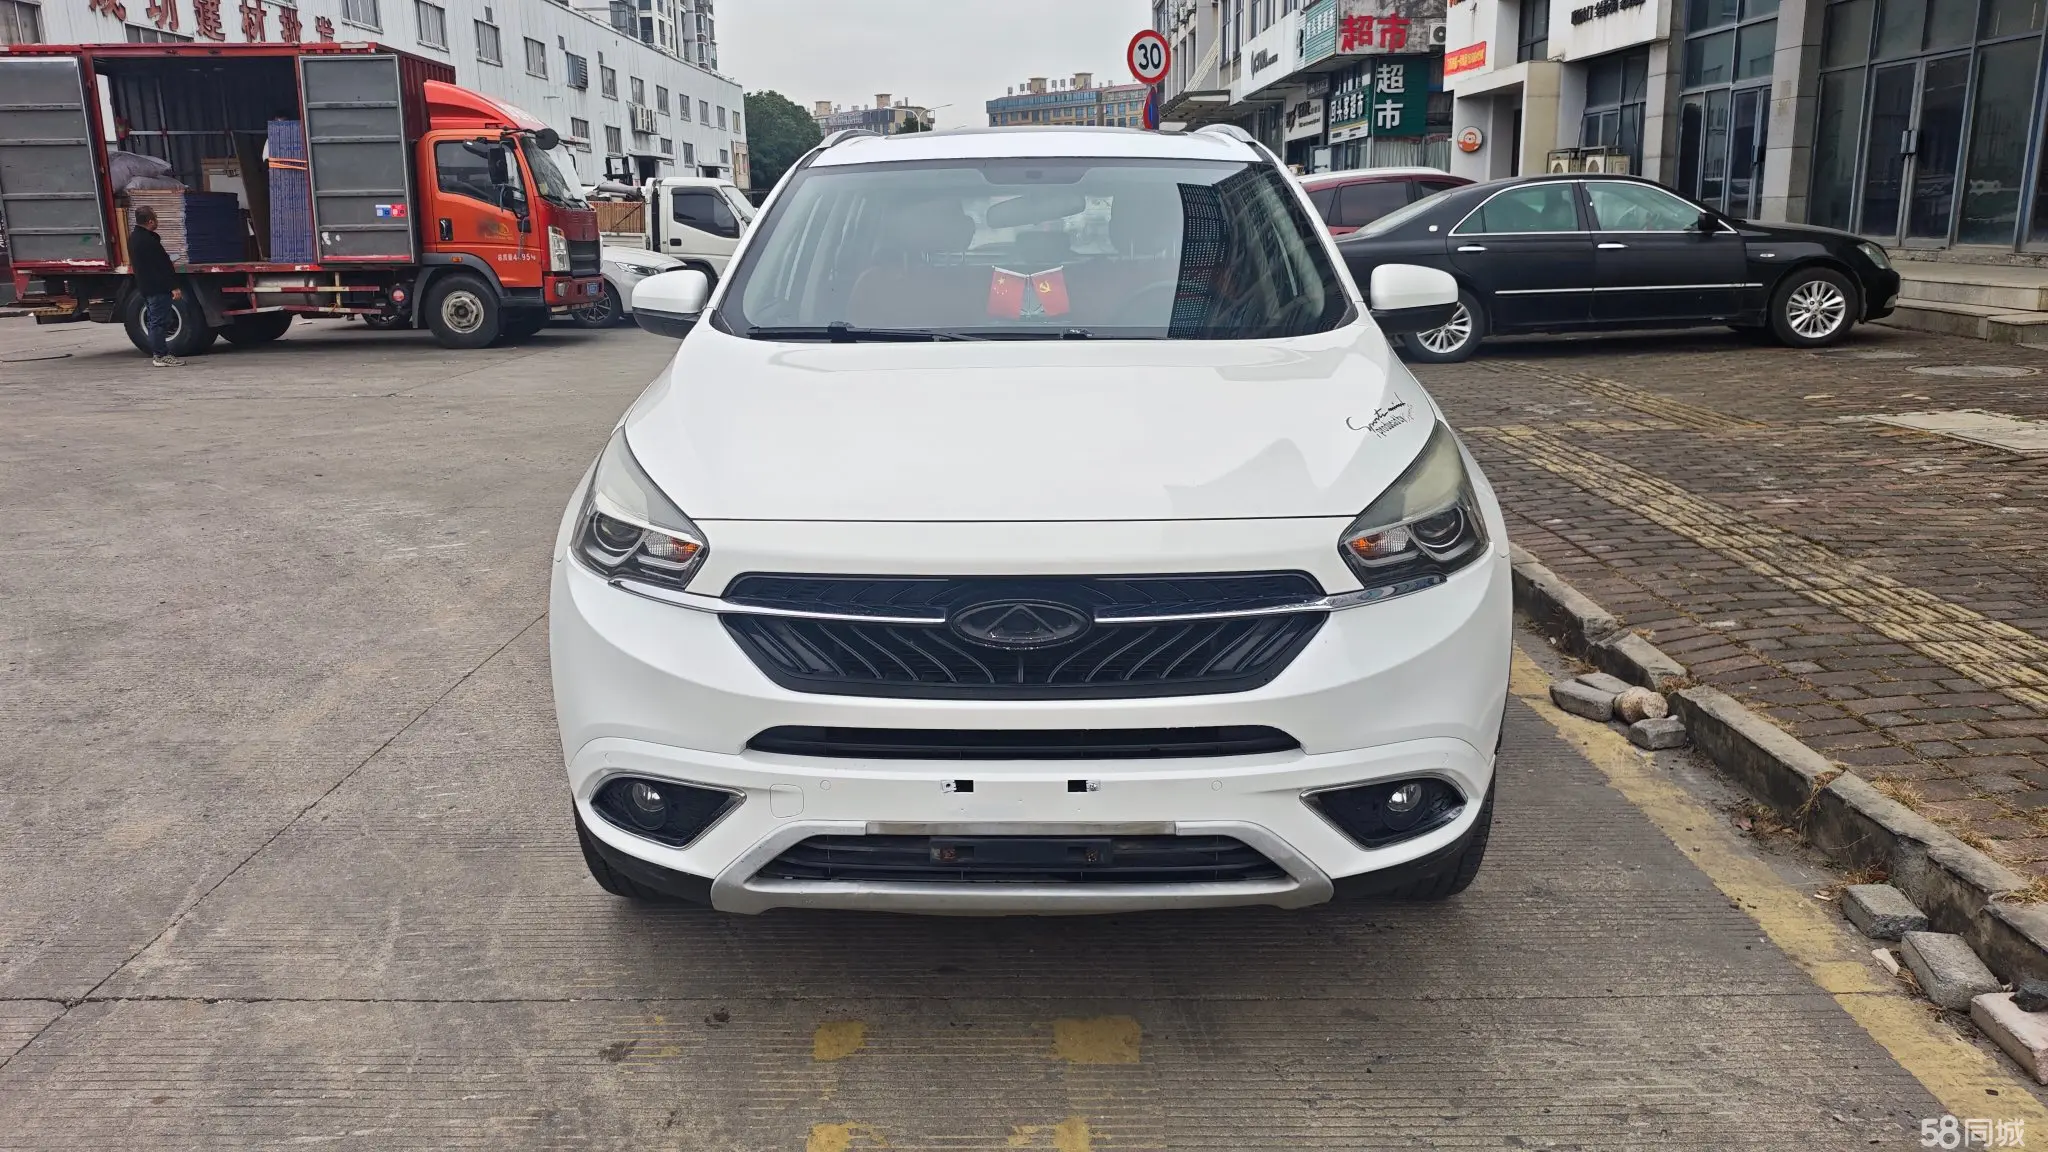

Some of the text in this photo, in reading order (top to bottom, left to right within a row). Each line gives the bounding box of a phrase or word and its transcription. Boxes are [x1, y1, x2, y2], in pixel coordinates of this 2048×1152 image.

[1340, 12, 1411, 53] 超市
[1138, 43, 1162, 70] 30
[1329, 91, 1364, 124] 回头客超市
[1374, 64, 1405, 129] 超市
